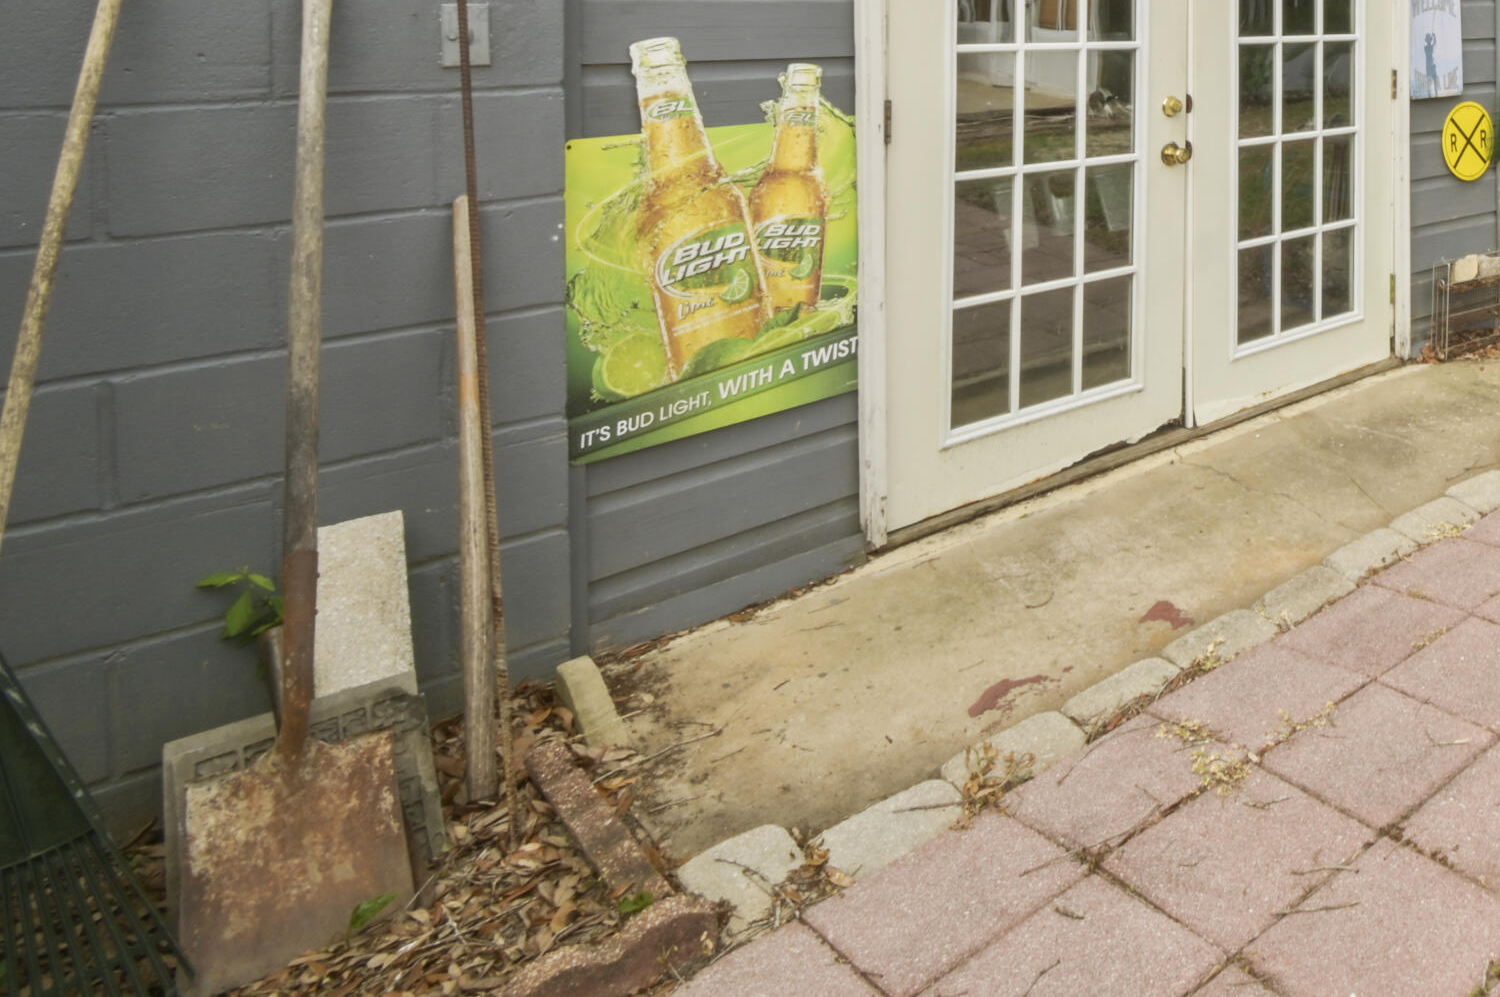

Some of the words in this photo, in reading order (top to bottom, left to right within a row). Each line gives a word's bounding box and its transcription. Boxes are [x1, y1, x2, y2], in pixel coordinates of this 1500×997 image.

[1450, 133, 1458, 153] R
[1480, 129, 1488, 149] R
[763, 224, 821, 238] BUD
[673, 232, 745, 266] BUD
[662, 245, 751, 288] LIGHT
[580, 425, 611, 449] IT'S
[616, 411, 655, 437] BUD
[659, 391, 712, 421] LIGHT,
[718, 364, 774, 399] WITH
[779, 358, 796, 379] A
